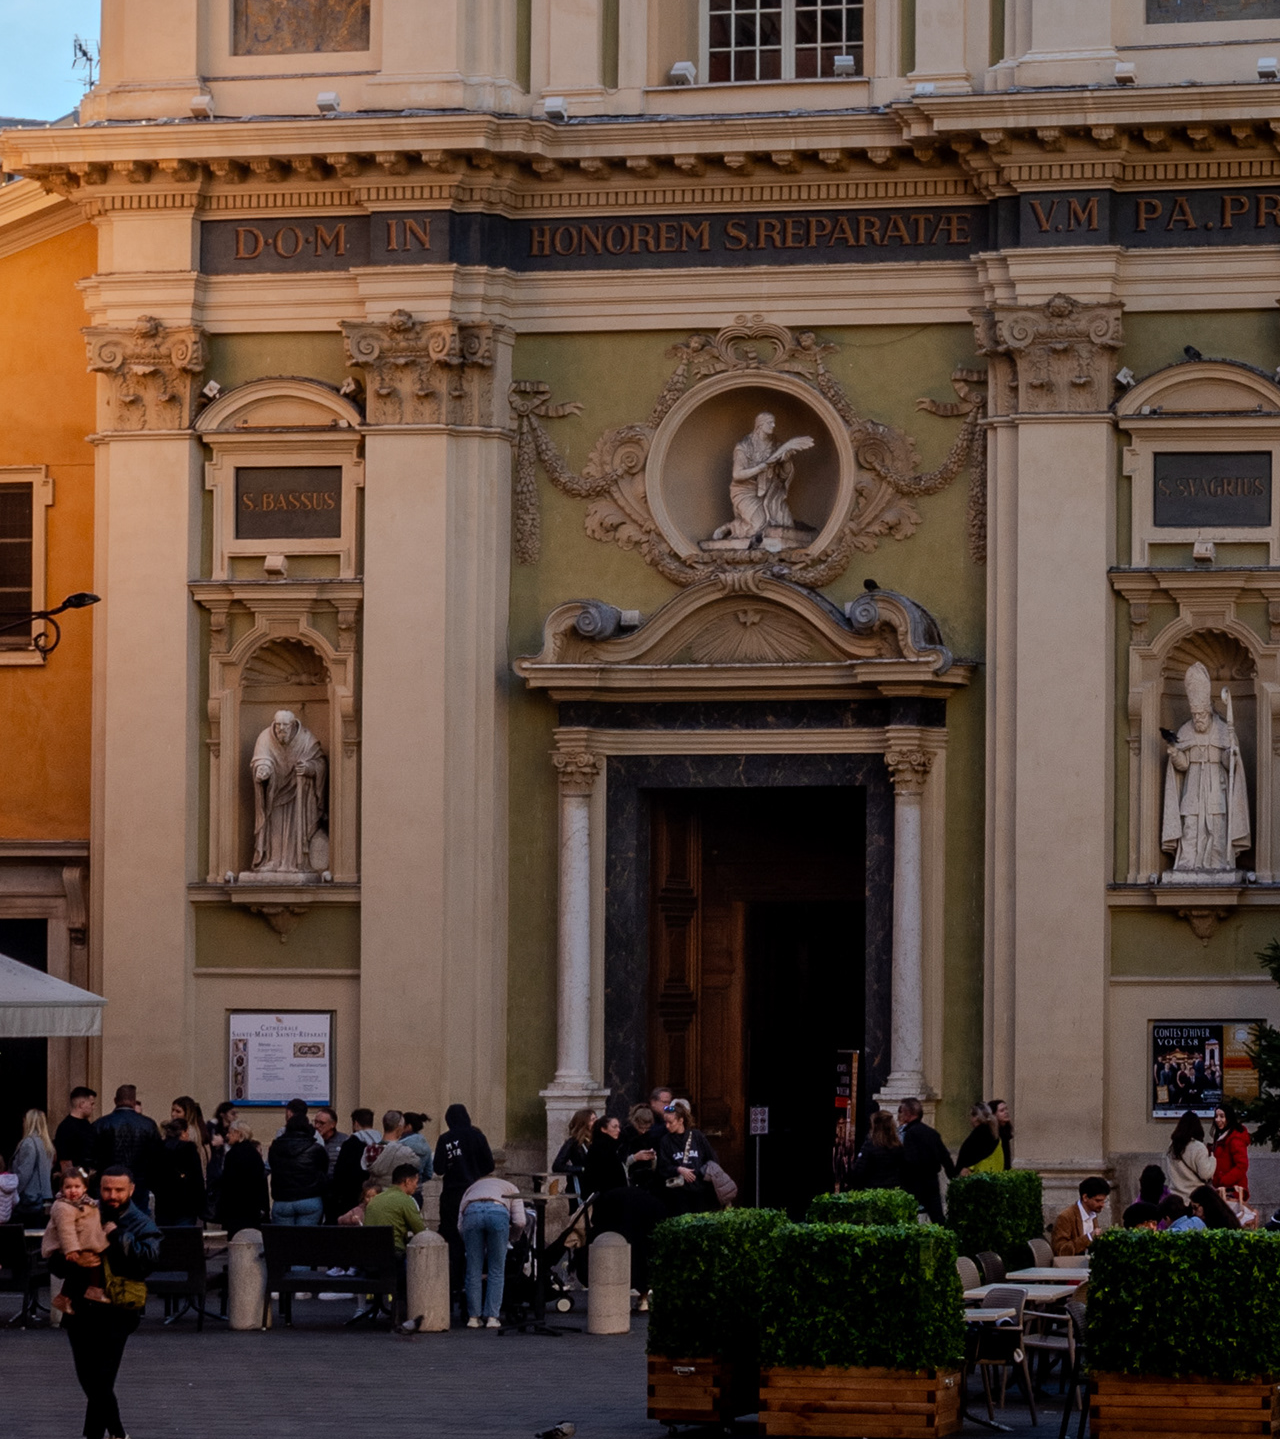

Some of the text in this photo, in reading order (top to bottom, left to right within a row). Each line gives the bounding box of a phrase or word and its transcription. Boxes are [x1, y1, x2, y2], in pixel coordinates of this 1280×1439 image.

[386, 219, 431, 252] IN
[529, 221, 712, 257] HONOREM
[1154, 1027, 1210, 1038] CONTES D'HIVER
[1157, 1038, 1199, 1047] VOCES8
